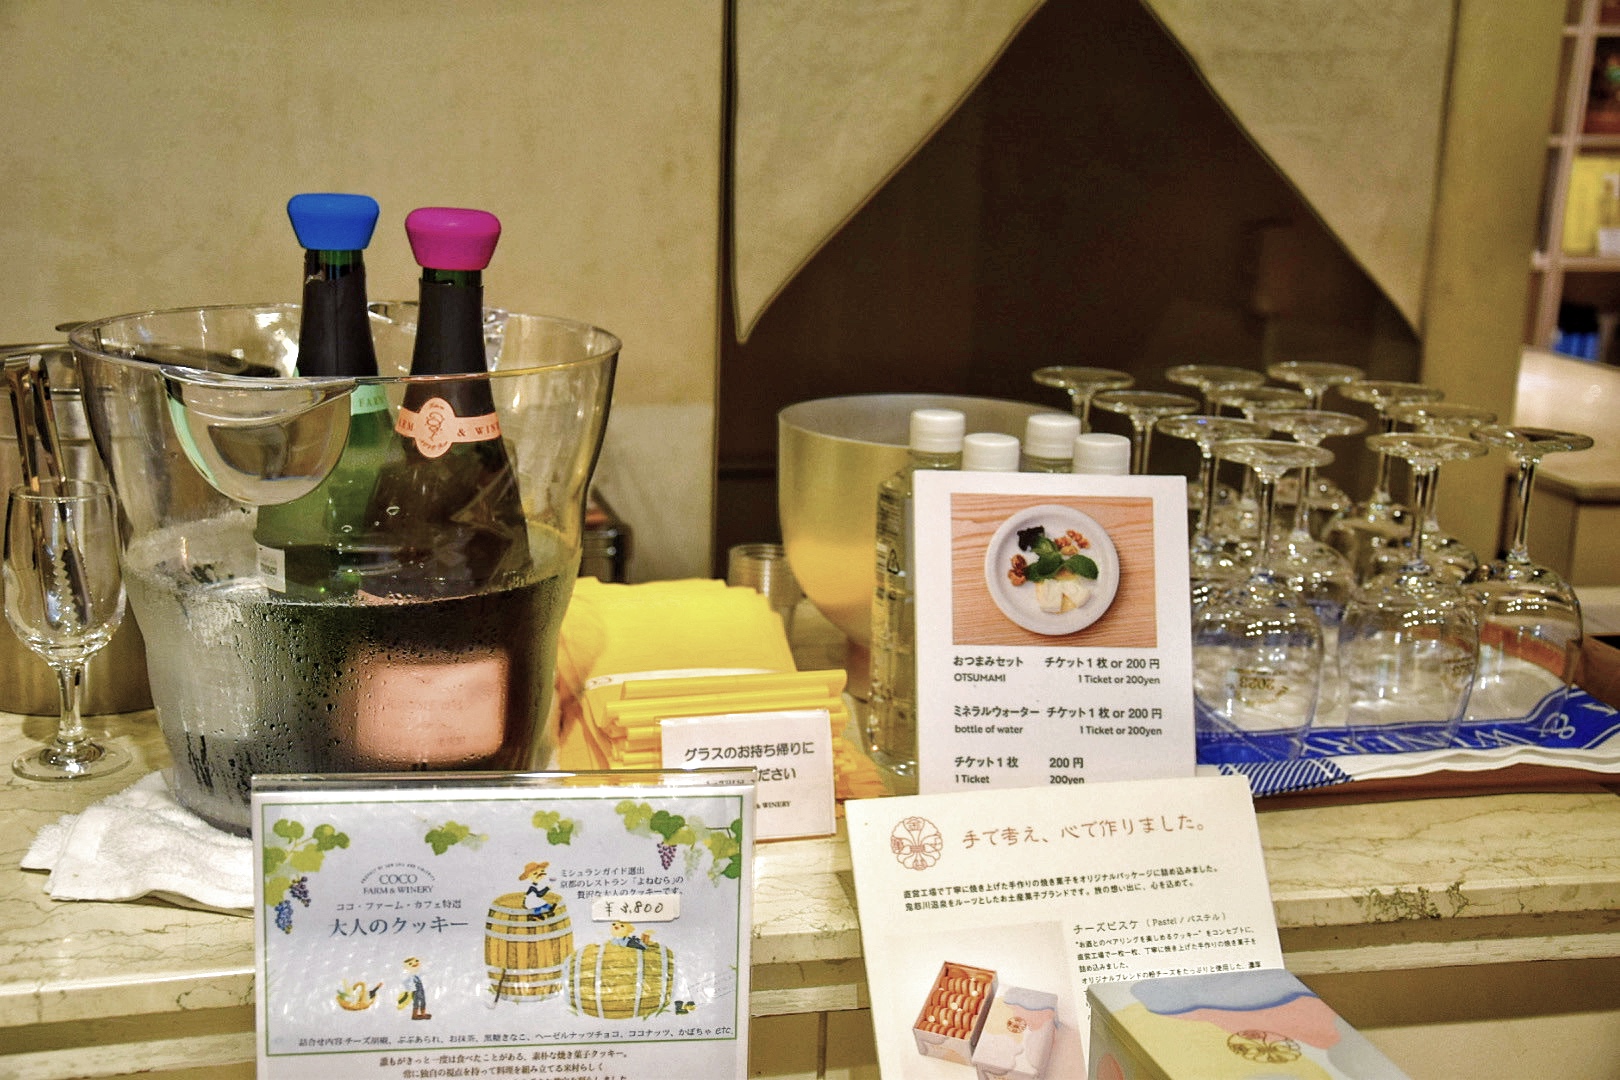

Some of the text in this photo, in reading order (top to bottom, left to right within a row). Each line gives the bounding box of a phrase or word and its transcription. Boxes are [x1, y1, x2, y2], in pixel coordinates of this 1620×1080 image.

[953, 656, 1024, 667] おつまみセット
[1111, 660, 1123, 669] or
[953, 673, 1006, 683] OTSUMAMI
[1084, 674, 1112, 684] Ticket
[1126, 675, 1160, 686] 200yen
[953, 705, 1040, 717] ミネラルウォーター
[1112, 709, 1125, 719] or
[954, 725, 983, 734] bottle
[985, 724, 995, 734] of
[997, 726, 1023, 734] water
[1085, 726, 1114, 735] Ticket
[1127, 727, 1163, 737] 200yen
[684, 741, 815, 762] グラスのお持ち帰りに
[961, 774, 990, 784] Ticket
[1049, 775, 1085, 785] 200yen
[762, 800, 791, 809] WINERY
[379, 873, 418, 885] COCO
[363, 886, 388, 895] FARM
[397, 885, 434, 894] WINERY
[329, 916, 469, 937] 大人のクッキー
